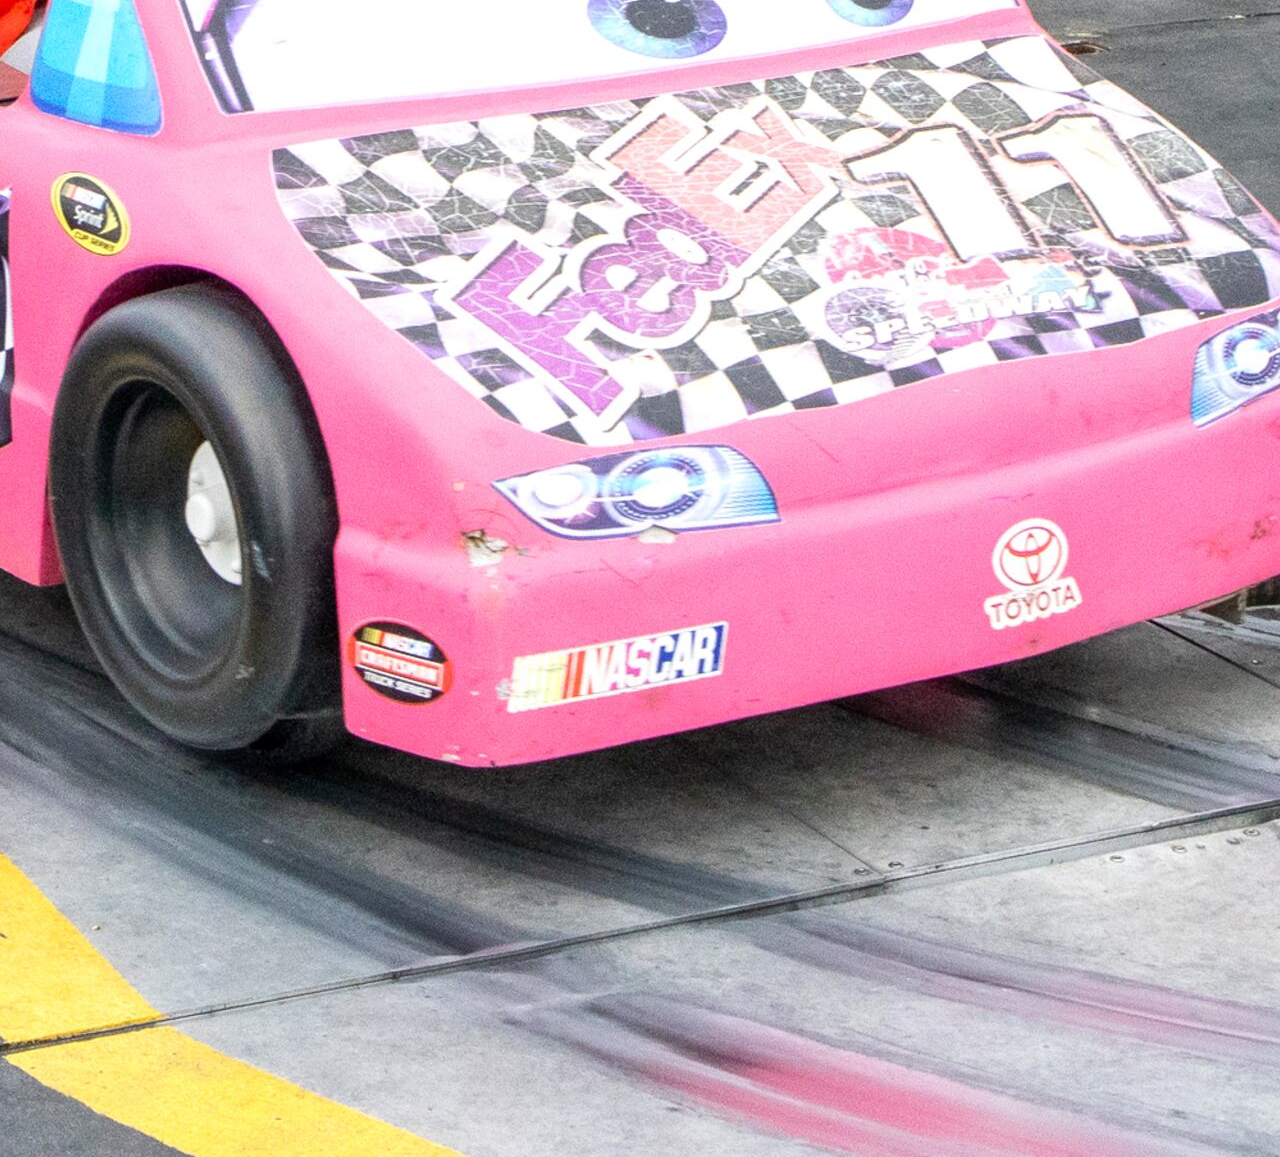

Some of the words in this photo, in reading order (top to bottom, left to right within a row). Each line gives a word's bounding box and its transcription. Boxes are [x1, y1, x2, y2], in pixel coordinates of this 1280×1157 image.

[841, 110, 1189, 260] 11
[73, 205, 104, 228] Sprint
[842, 285, 1092, 351] SPEEDWAY
[990, 584, 1077, 623] TOYOTA
[360, 648, 438, 685] CRAFTSMAN
[582, 625, 719, 696] NASCAR
